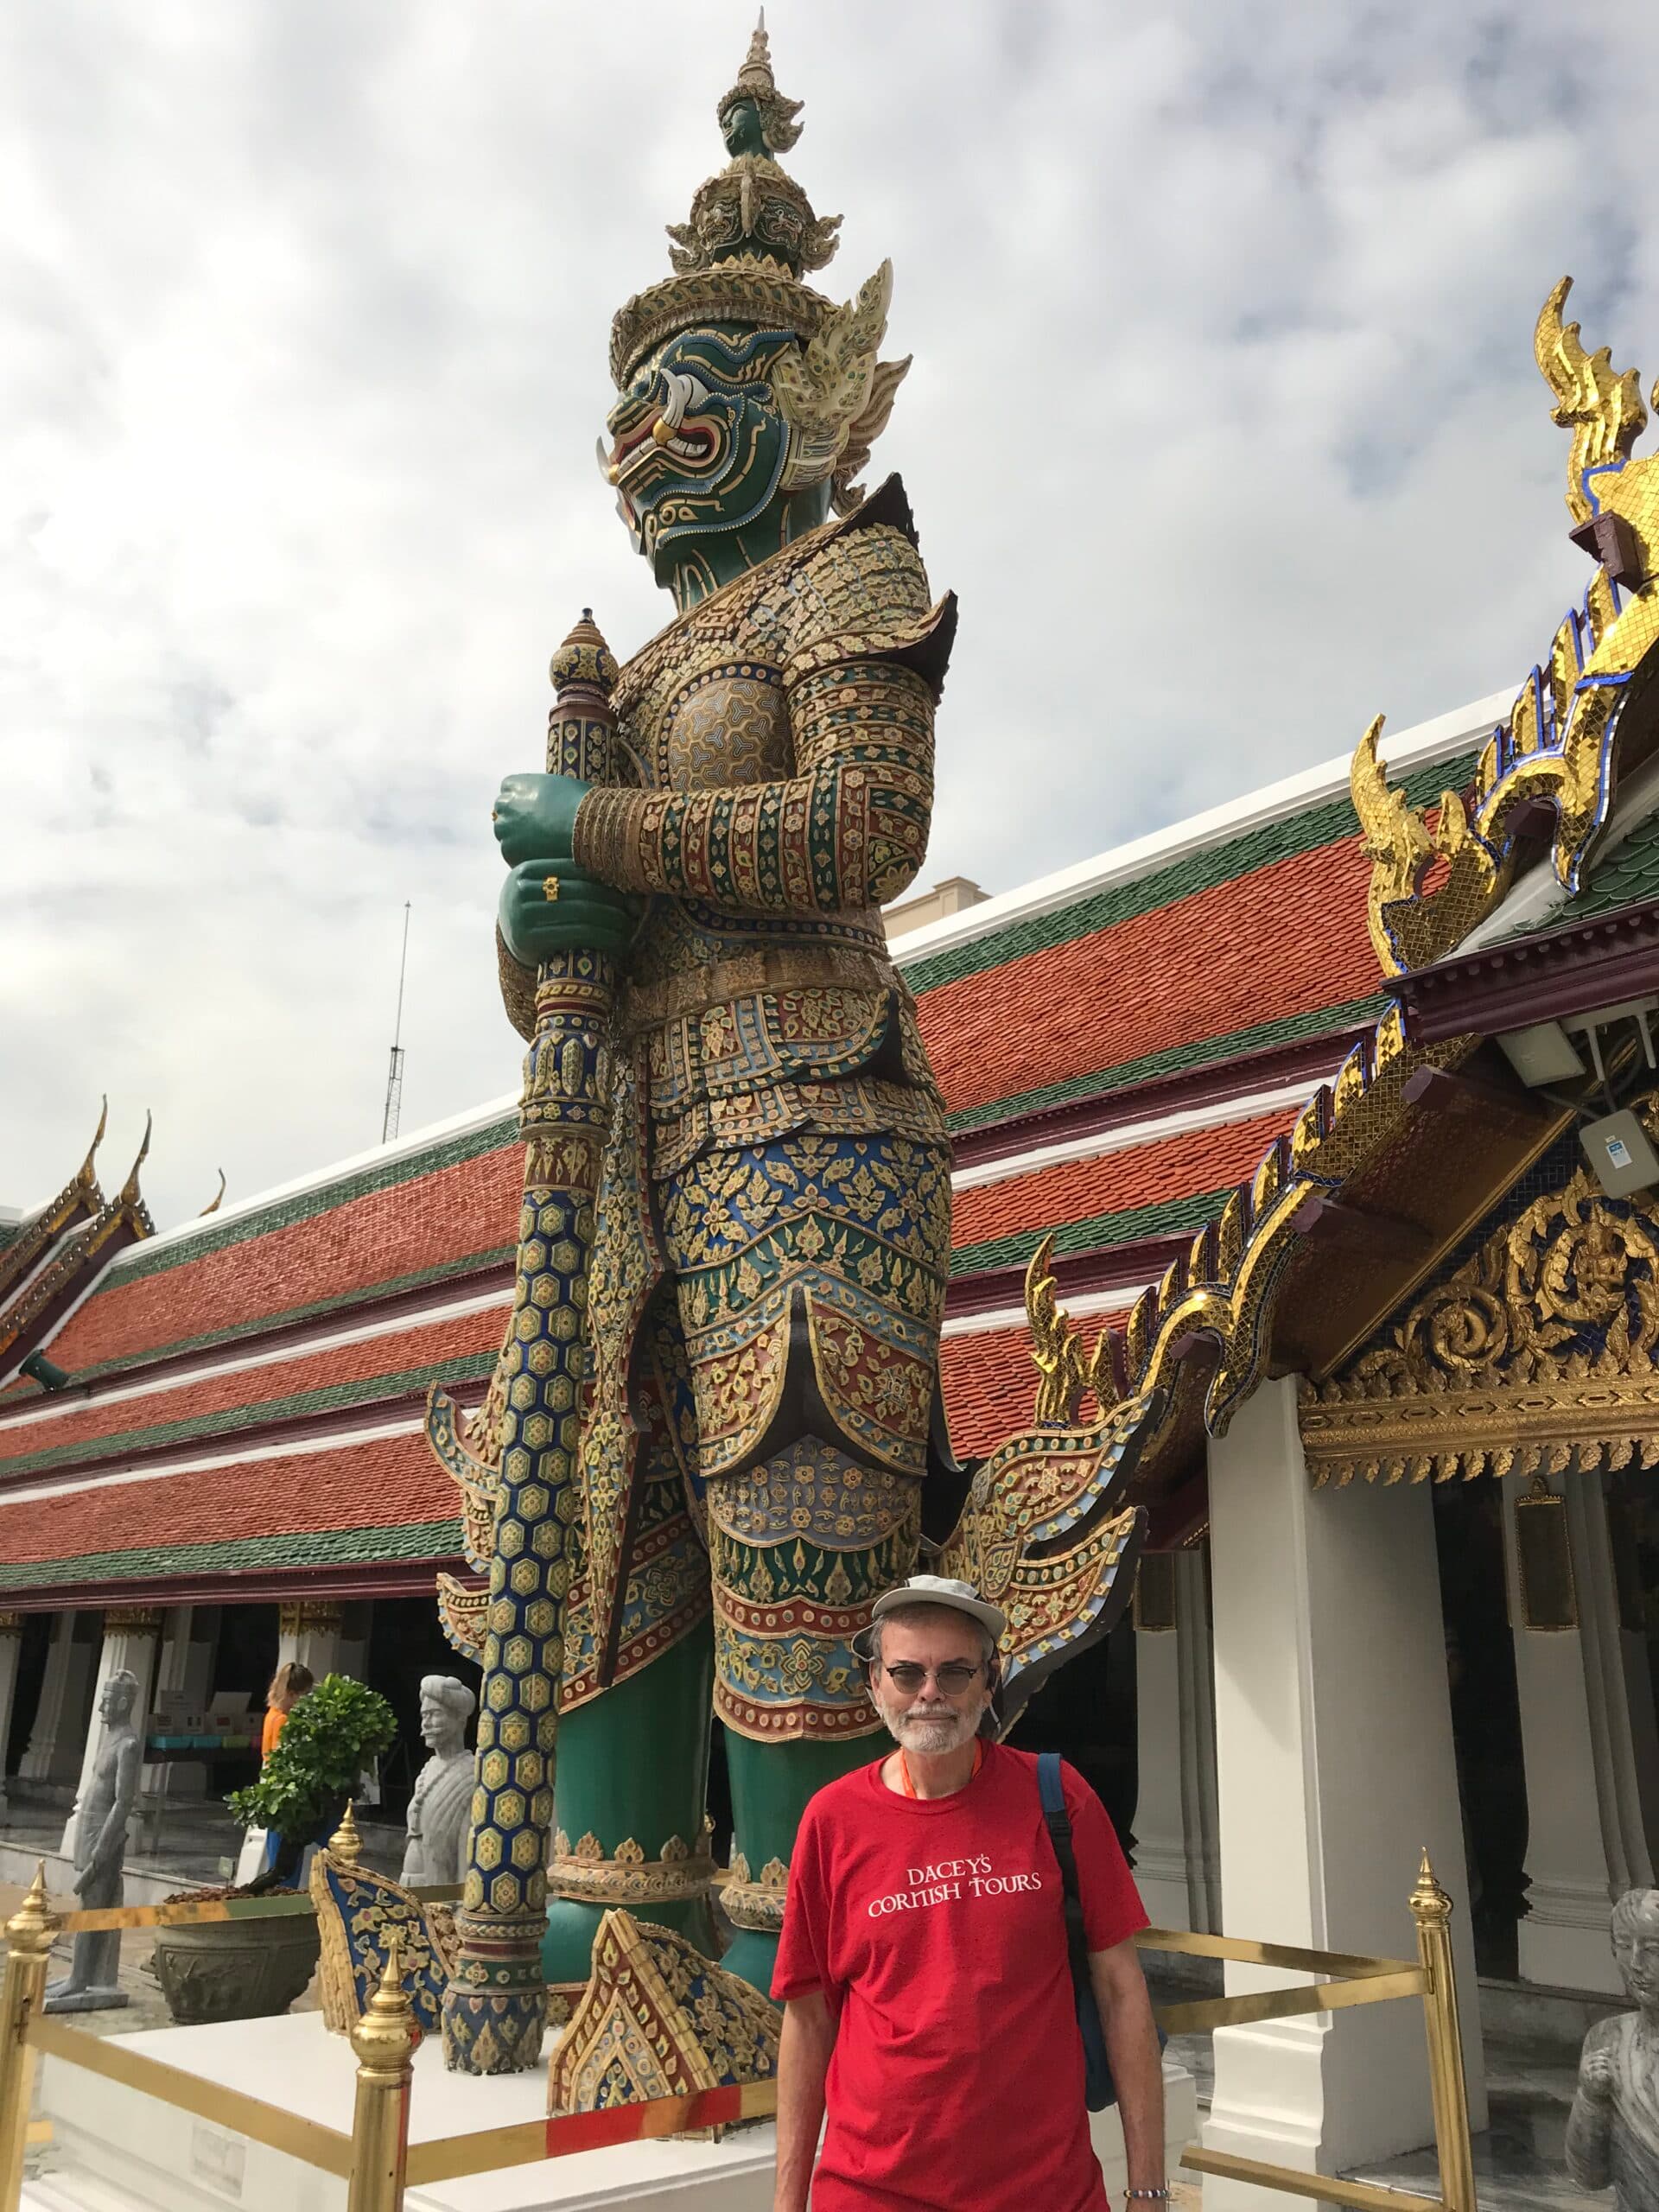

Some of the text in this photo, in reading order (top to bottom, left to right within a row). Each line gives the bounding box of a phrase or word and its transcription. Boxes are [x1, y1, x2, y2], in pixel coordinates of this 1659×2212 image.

[906, 1853, 992, 1885] DACEY'S
[868, 1872, 1042, 1917] CORNISH TOURS
